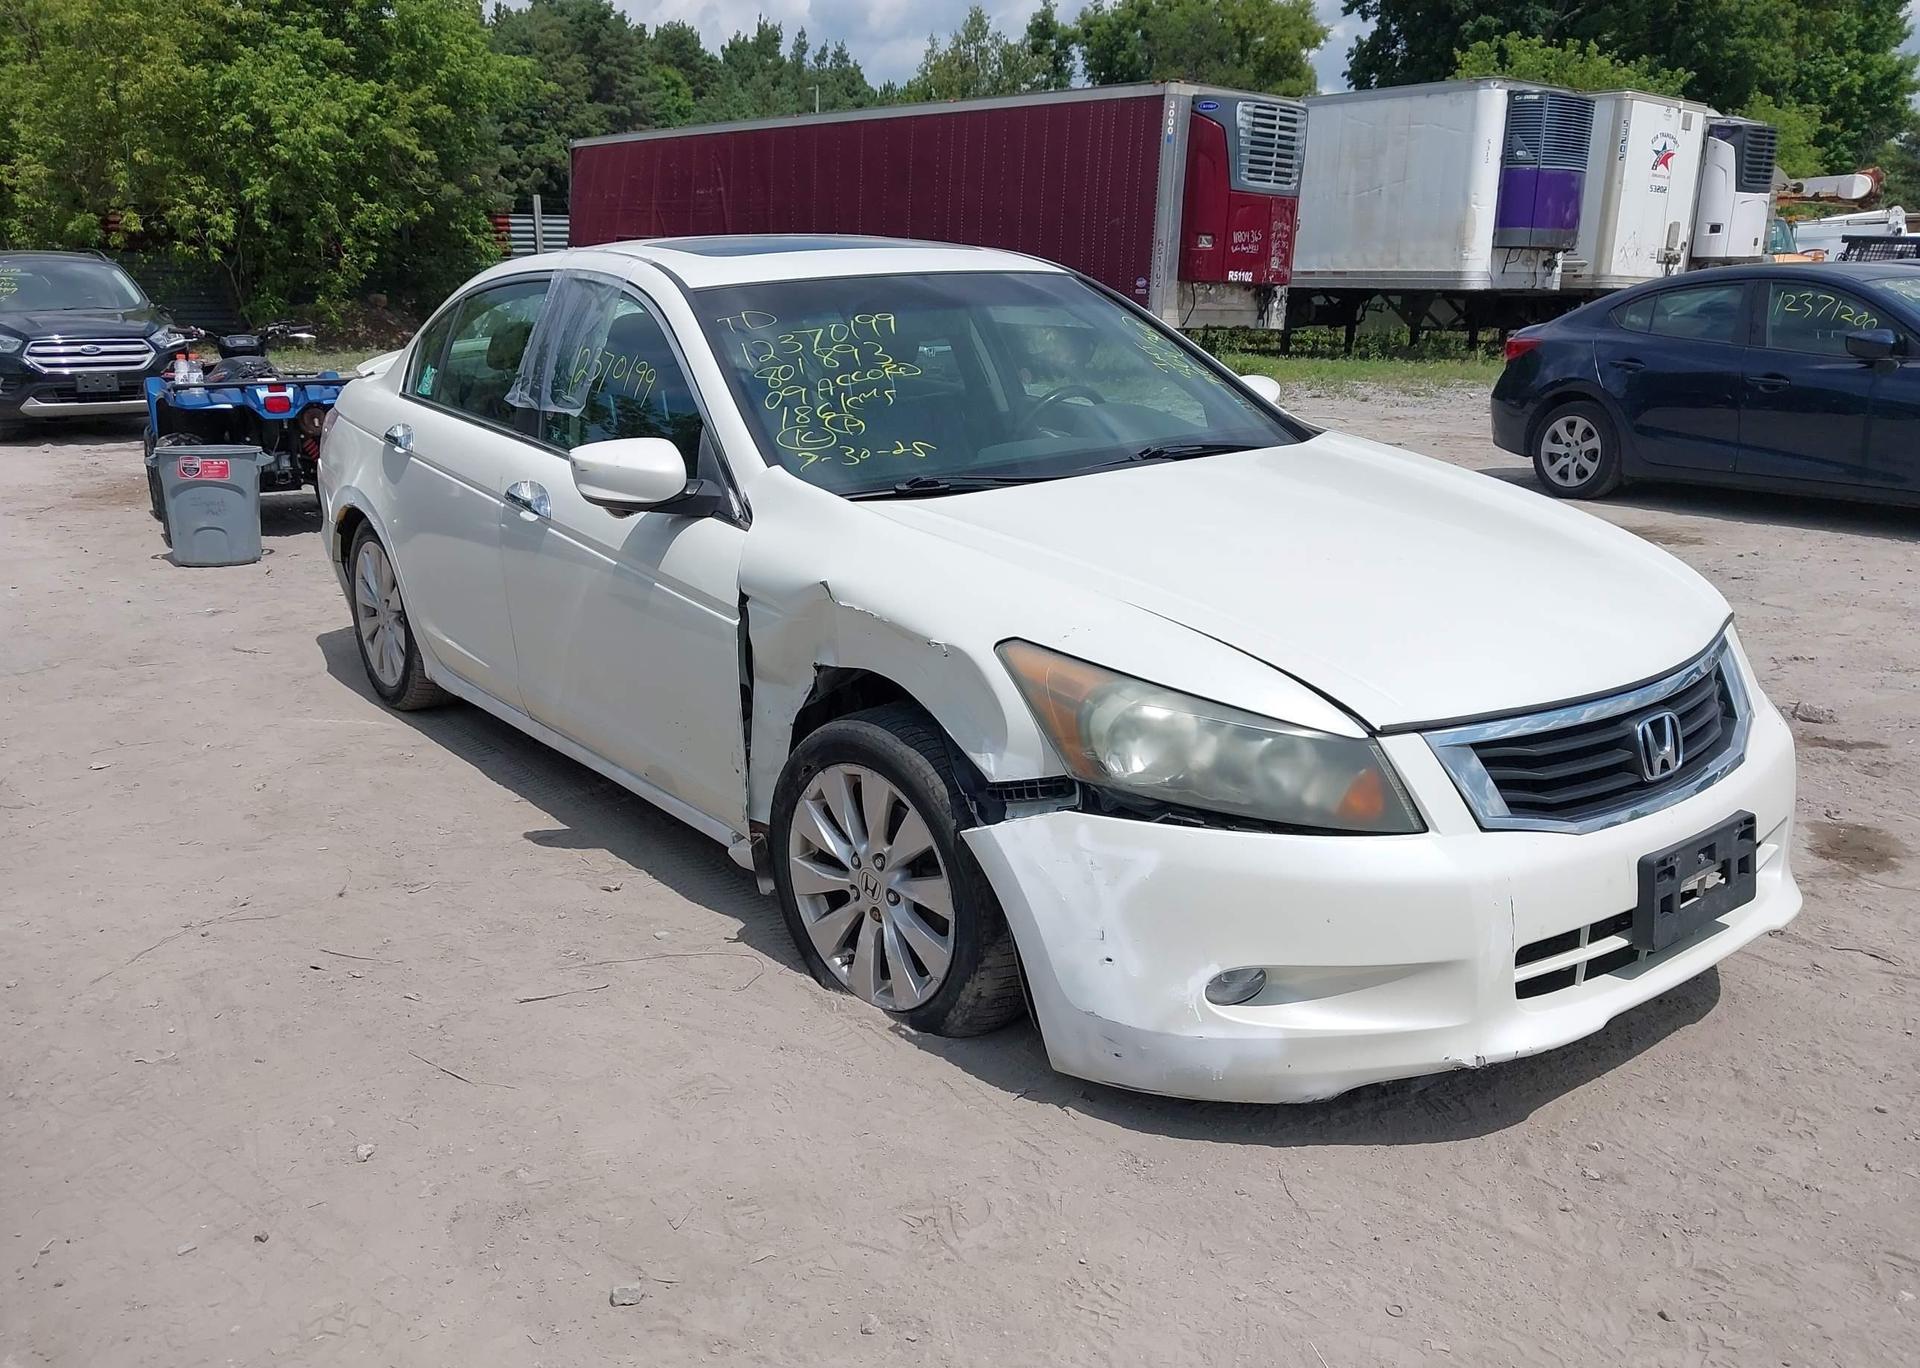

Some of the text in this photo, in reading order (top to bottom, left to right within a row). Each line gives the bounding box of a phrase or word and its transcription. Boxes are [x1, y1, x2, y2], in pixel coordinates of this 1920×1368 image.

[1618, 119, 1629, 161] 53202
[1228, 270, 1253, 282] R51102
[1774, 291, 1878, 330] 12371200
[741, 313, 896, 369] 12370199
[567, 345, 657, 409] 12370199
